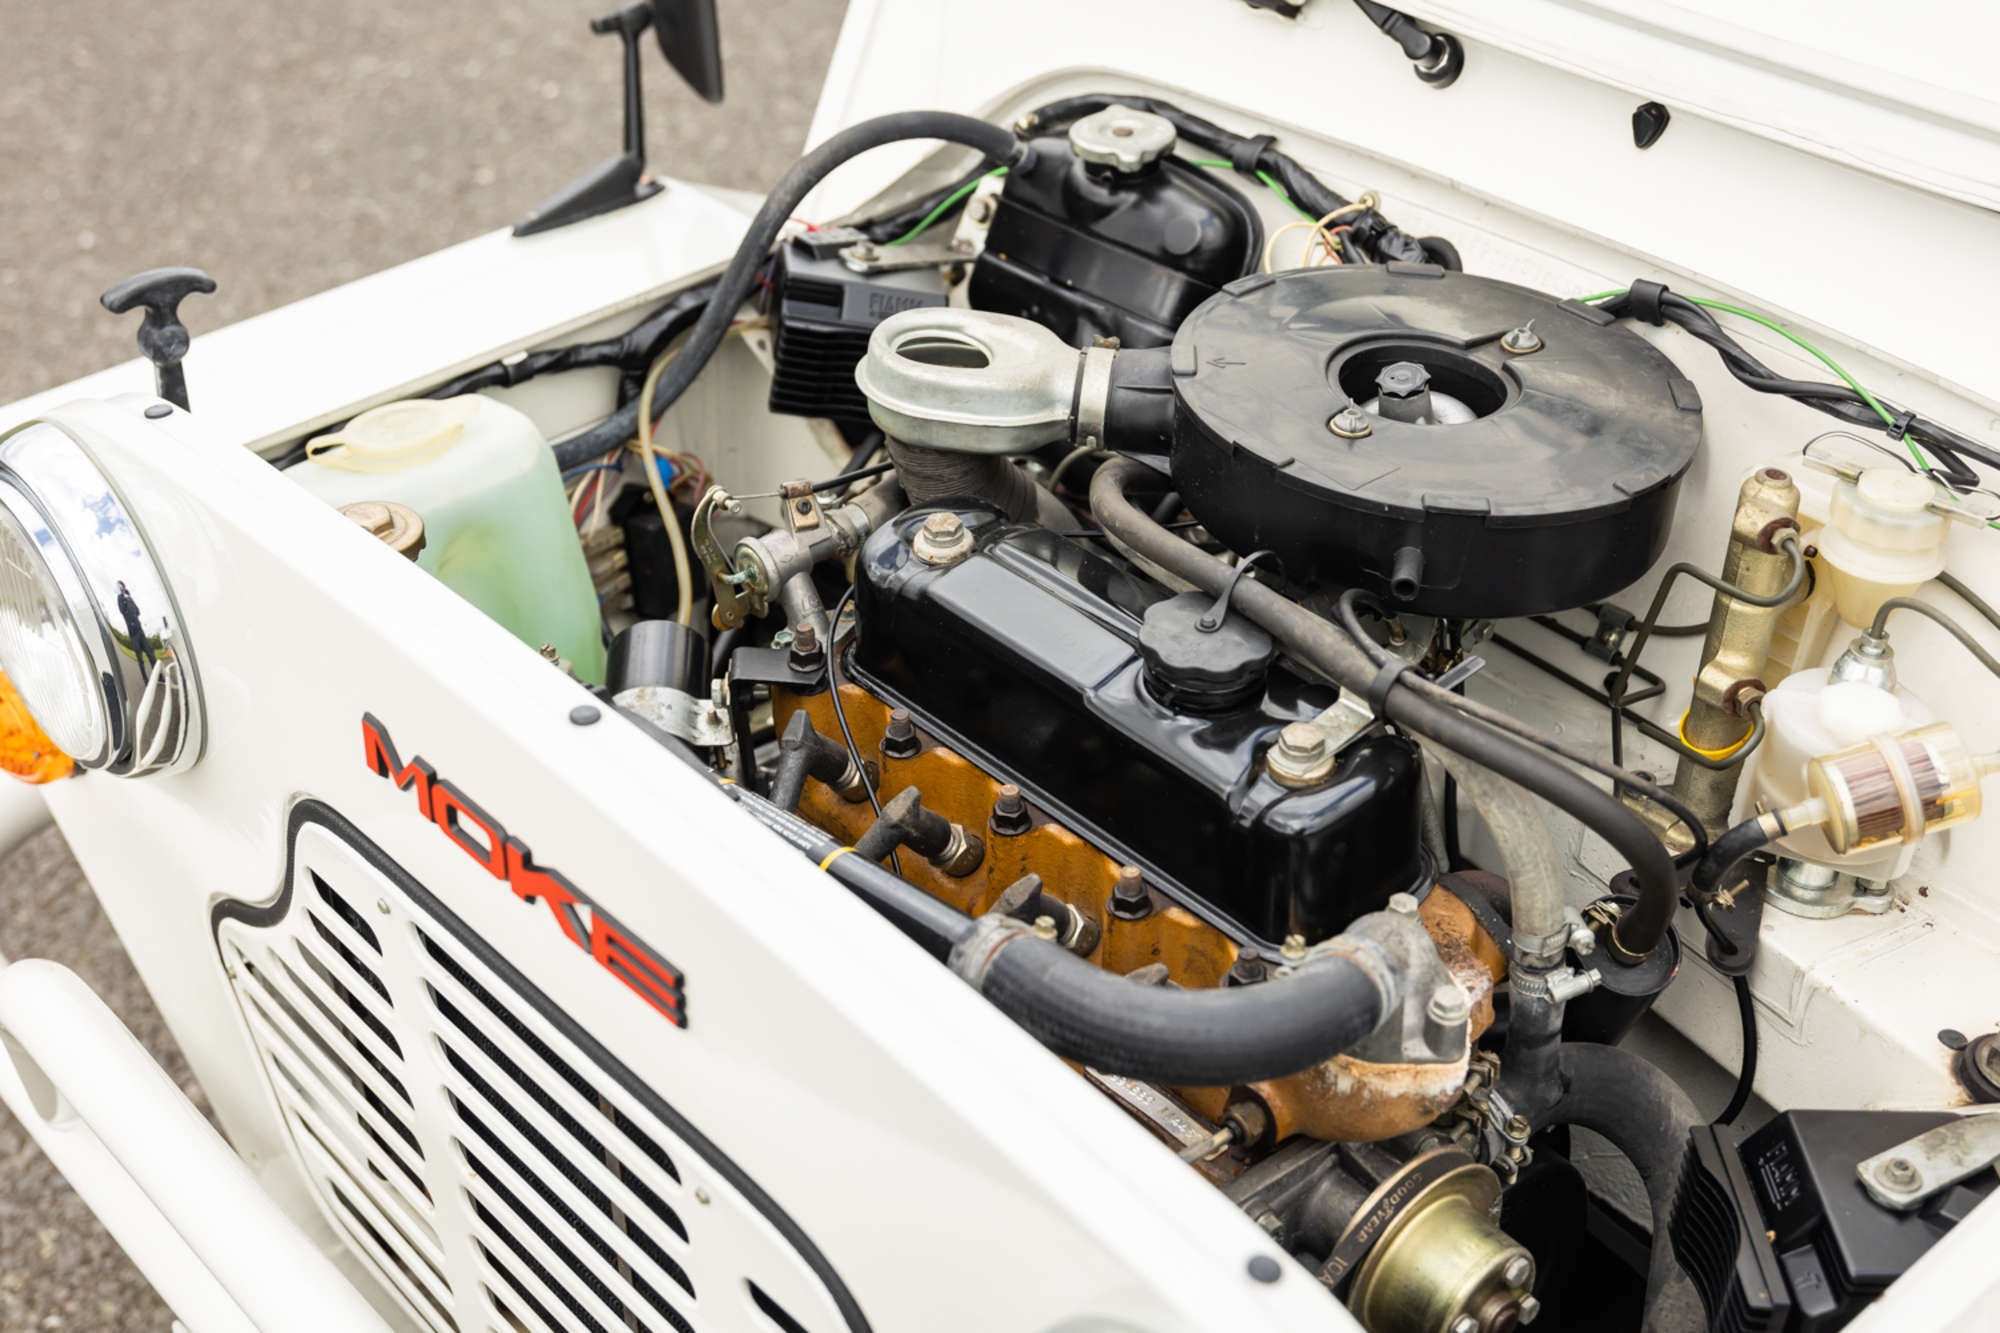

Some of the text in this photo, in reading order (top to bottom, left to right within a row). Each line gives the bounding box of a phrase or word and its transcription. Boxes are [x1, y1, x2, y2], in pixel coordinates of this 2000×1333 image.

[362, 711, 688, 1030] MOKE
[1315, 1172, 1424, 1290] GOODYEAR 10A
